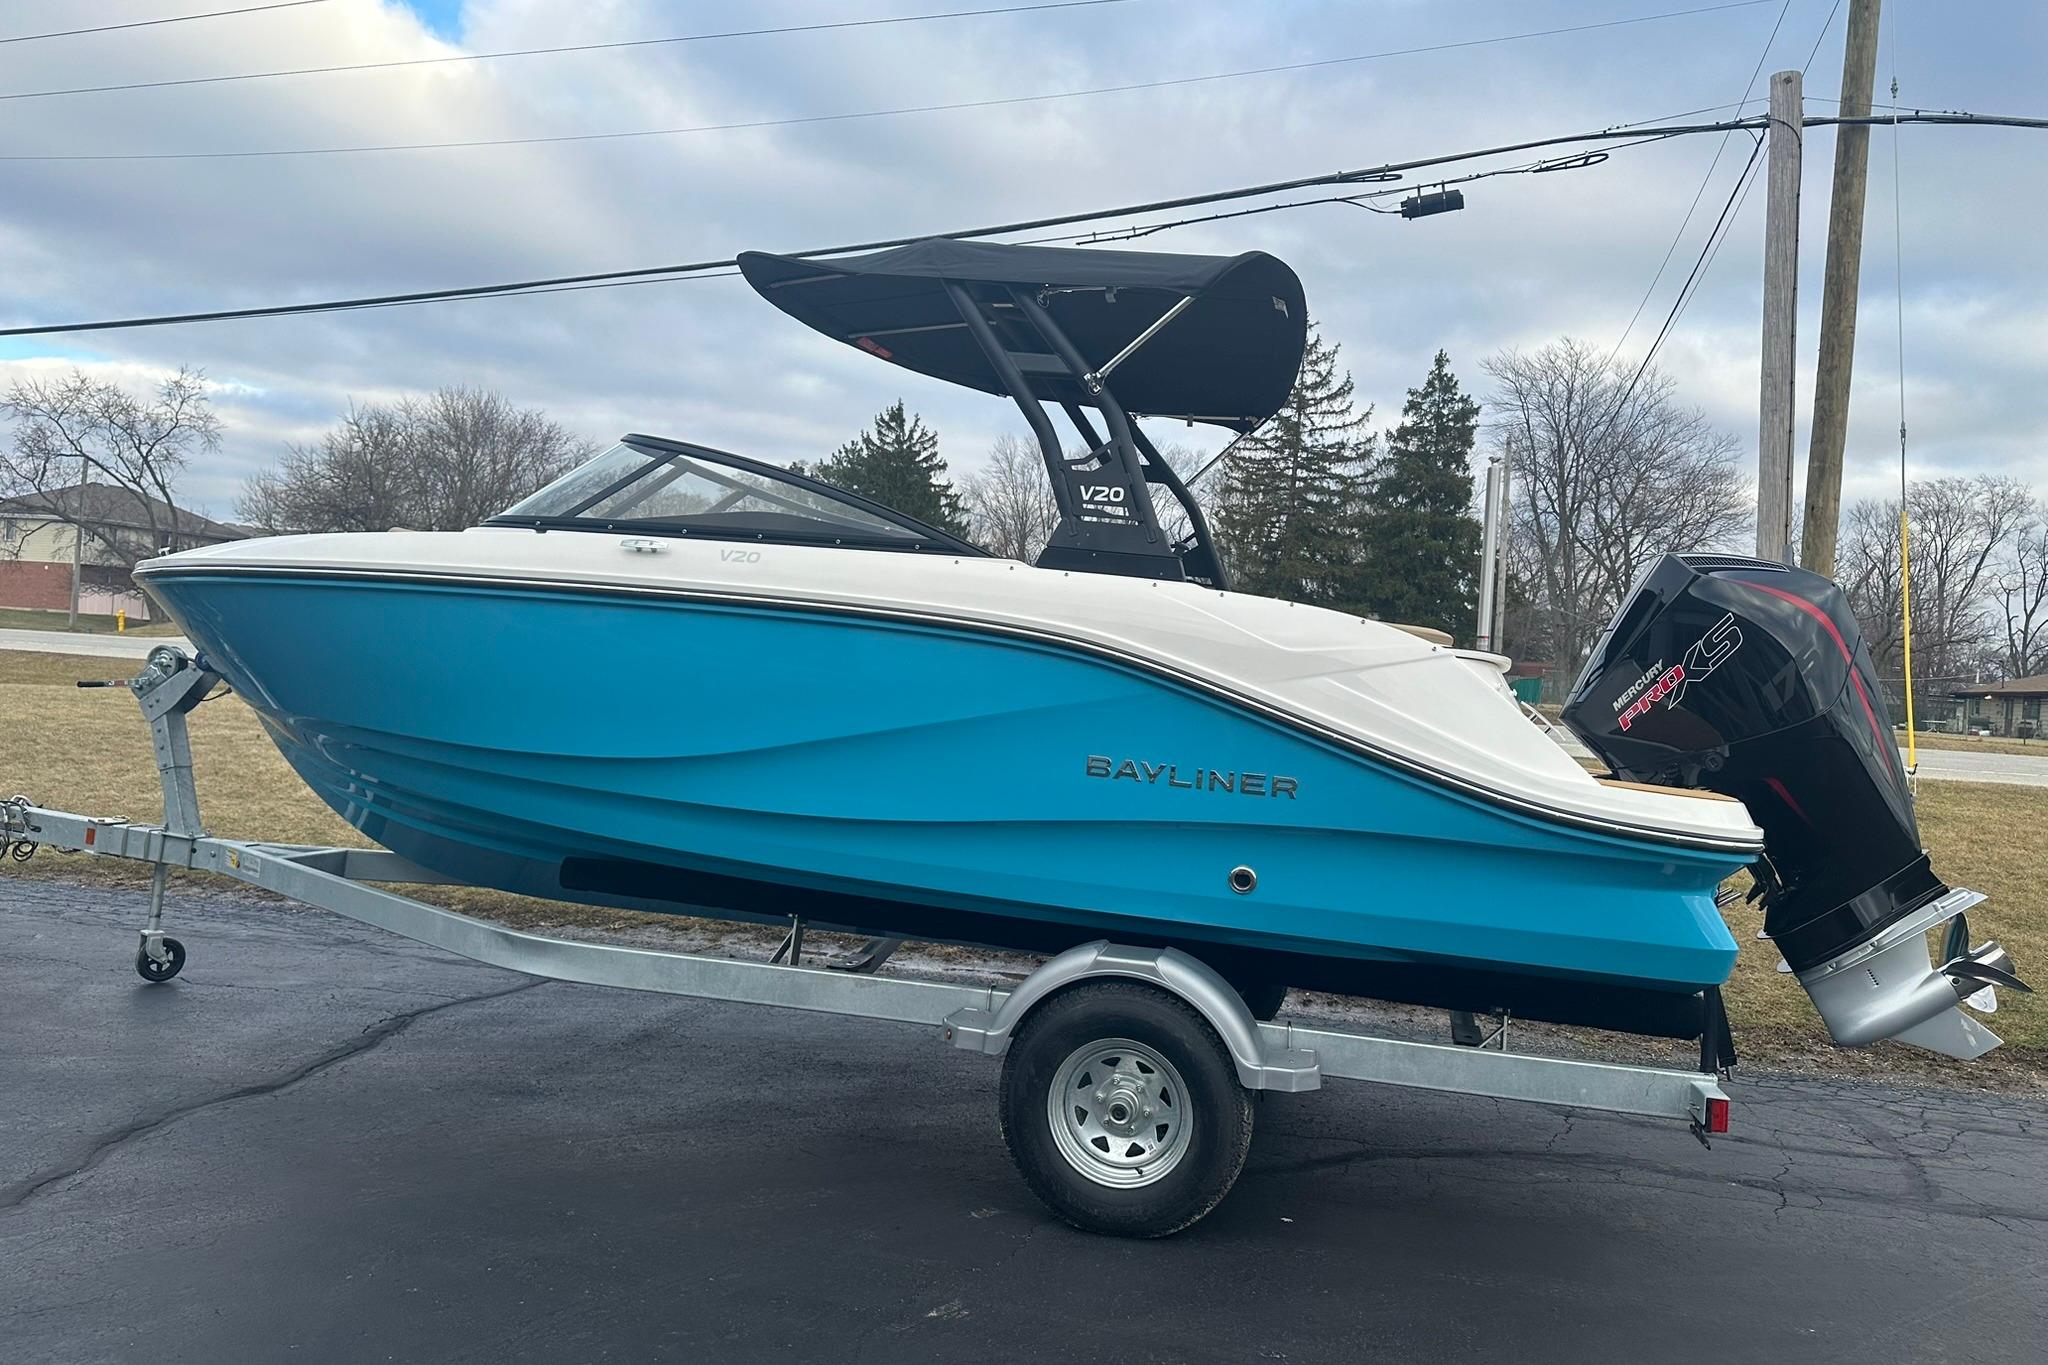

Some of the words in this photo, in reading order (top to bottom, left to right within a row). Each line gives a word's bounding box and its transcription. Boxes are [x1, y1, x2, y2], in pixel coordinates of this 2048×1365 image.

[1079, 485, 1125, 502] V20
[720, 549, 761, 563] V20
[1612, 658, 1664, 712] MERCURY
[1086, 754, 1299, 800] BAYLINER
